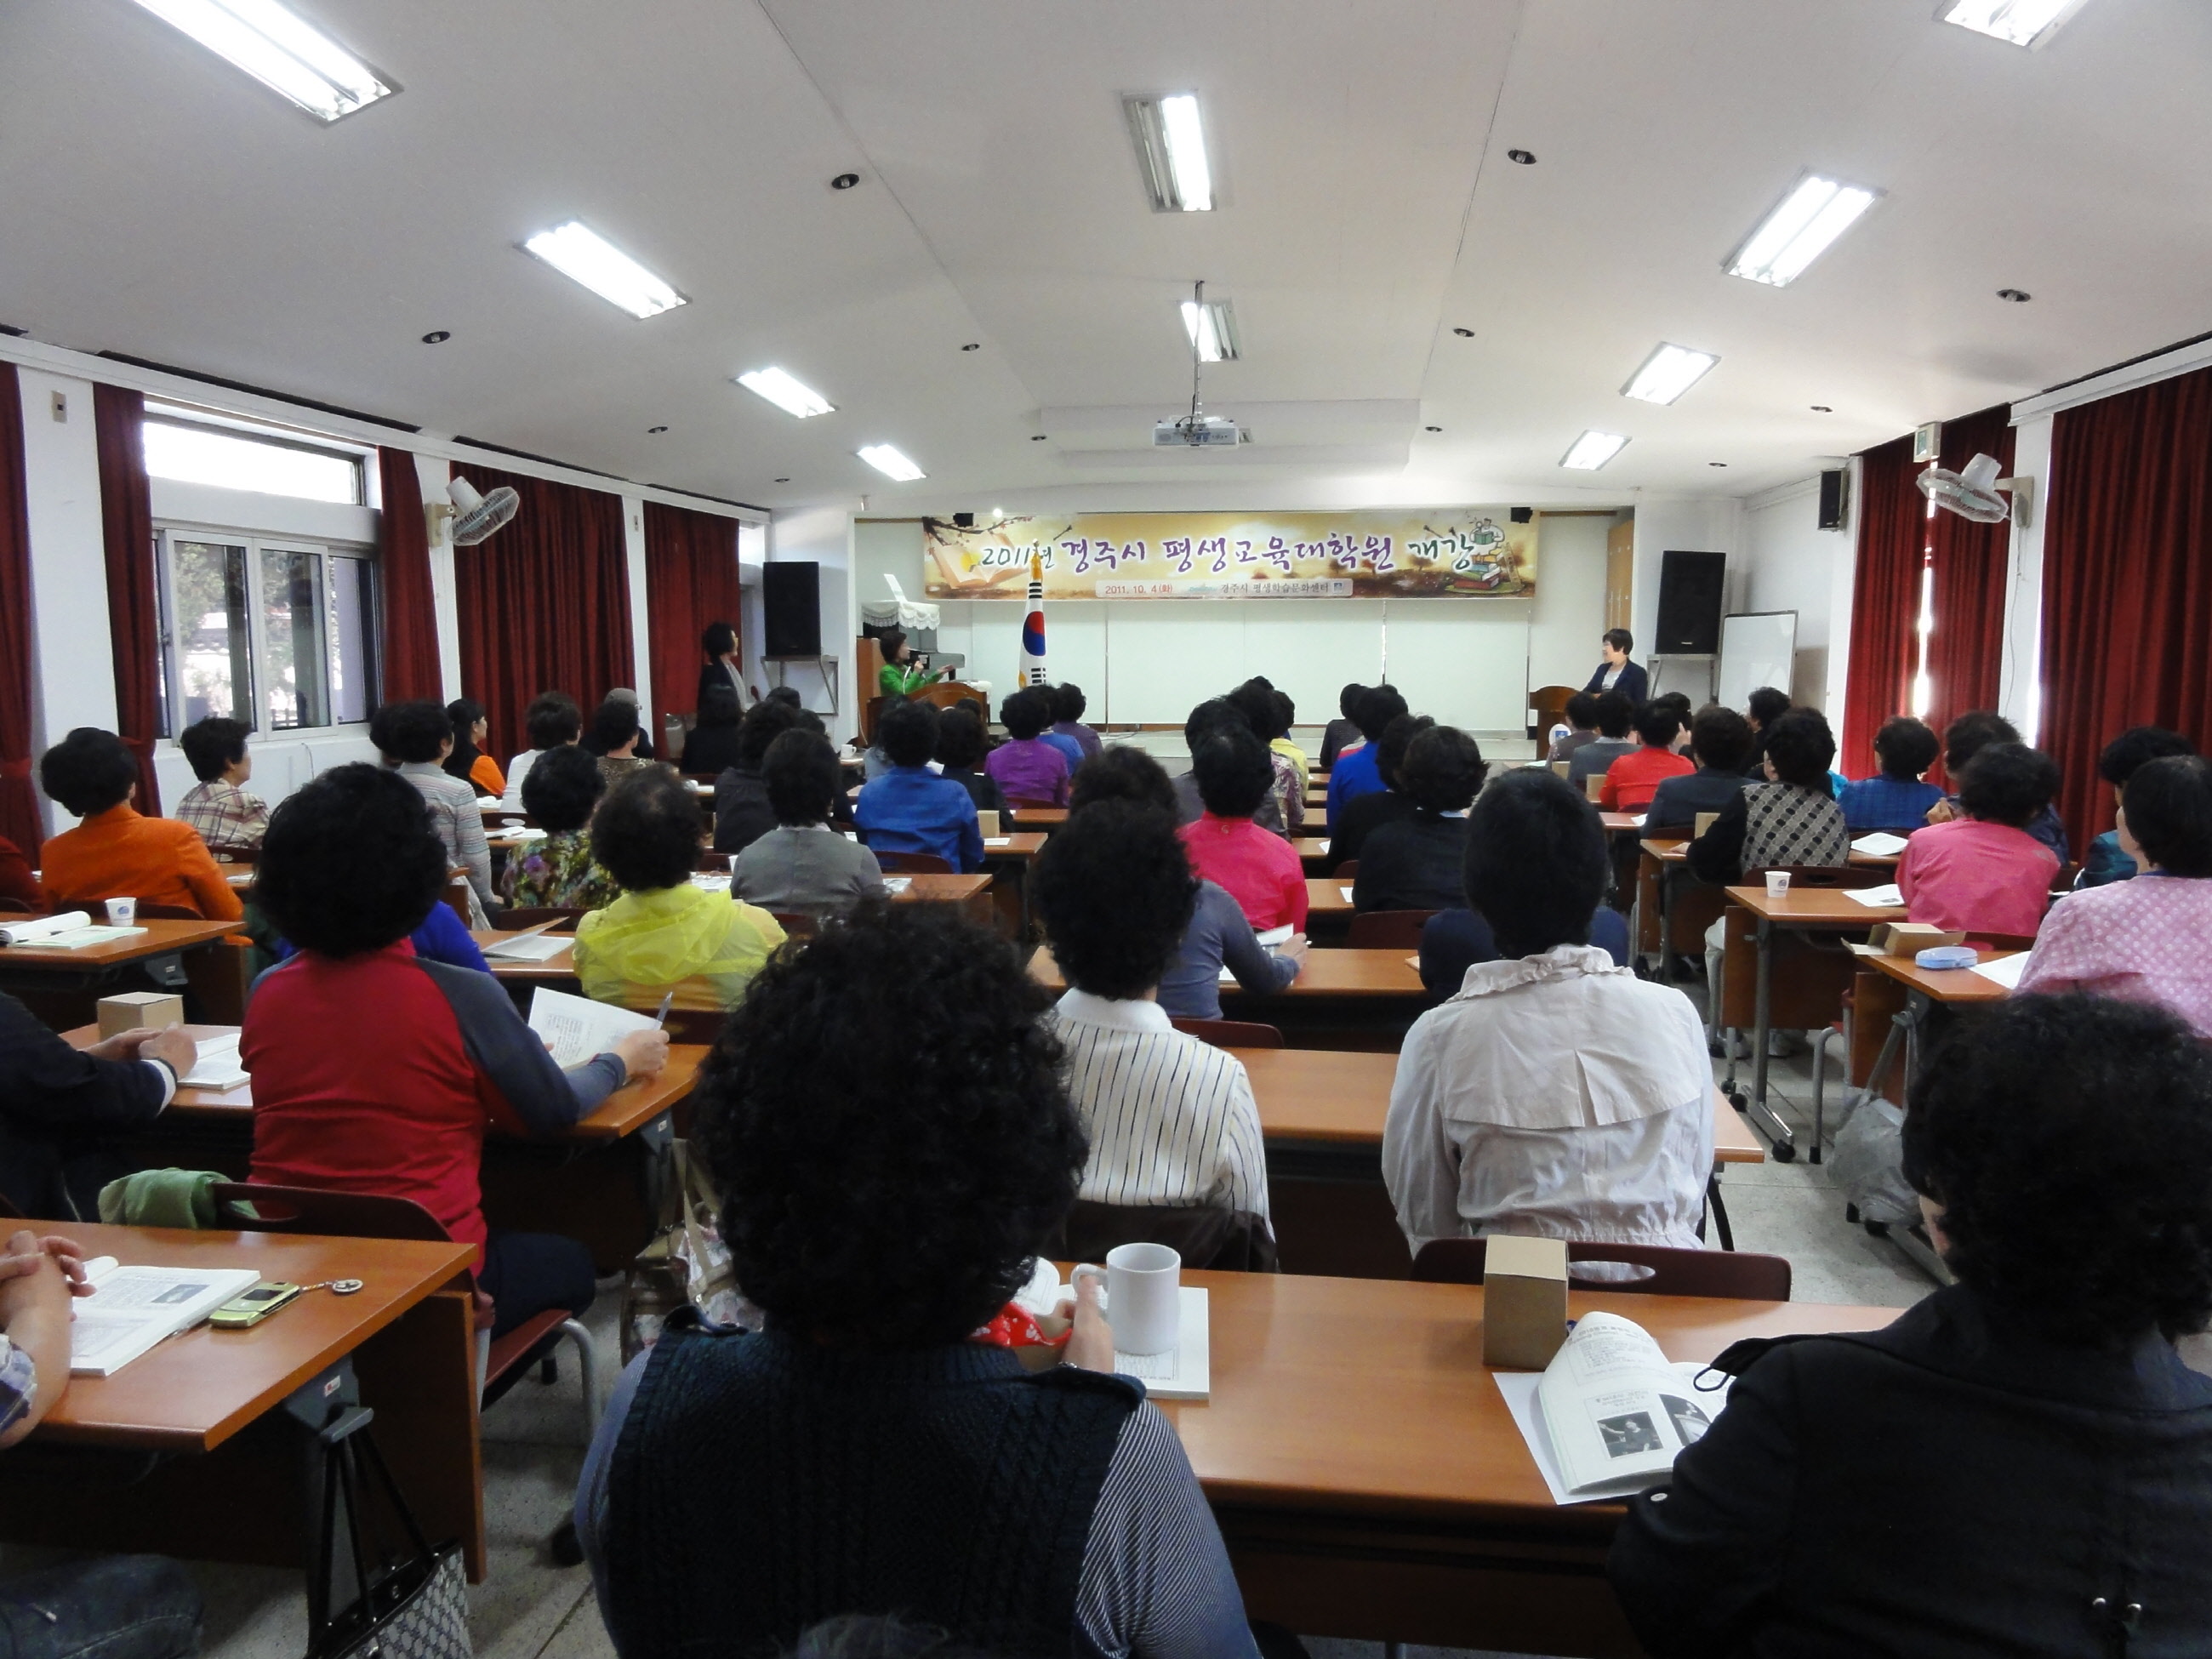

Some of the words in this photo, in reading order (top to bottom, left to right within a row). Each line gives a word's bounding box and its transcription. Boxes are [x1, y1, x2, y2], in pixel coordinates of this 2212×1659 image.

[1061, 539, 1146, 573] 경주시
[1408, 533, 1474, 570] 개강
[1105, 585, 1129, 595] 2011.
[1221, 583, 1248, 594] 경주시
[1253, 582, 1328, 594] 평생학습문화센터
